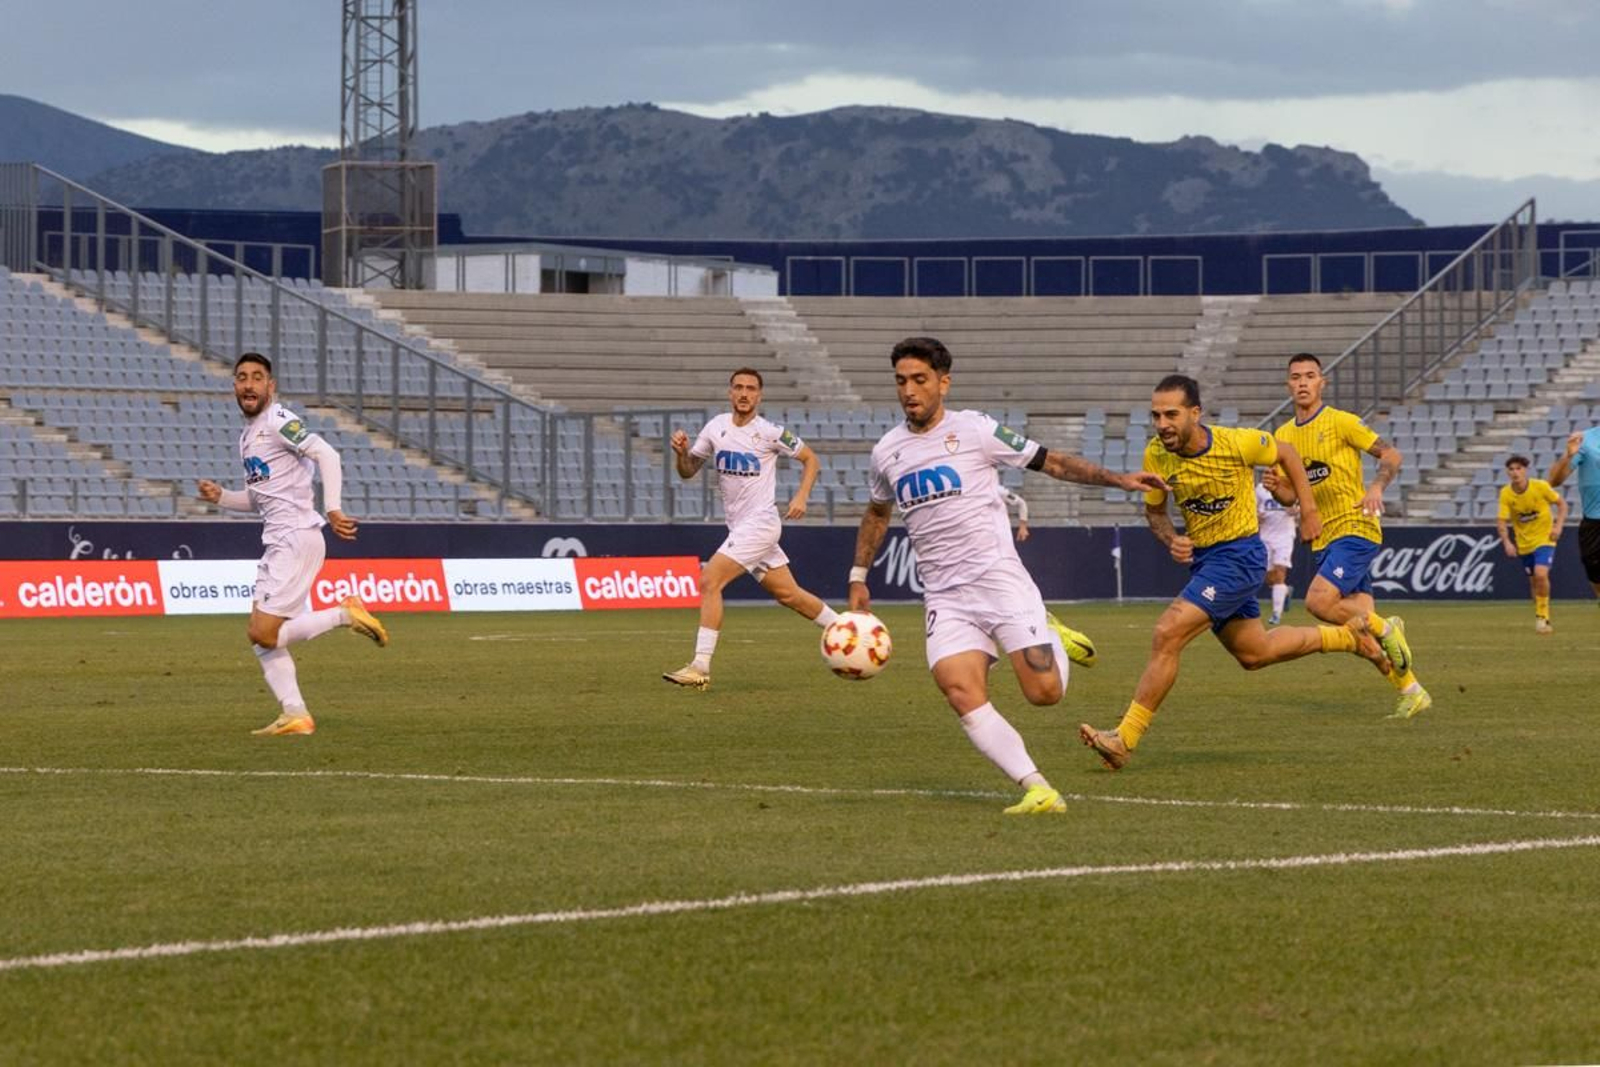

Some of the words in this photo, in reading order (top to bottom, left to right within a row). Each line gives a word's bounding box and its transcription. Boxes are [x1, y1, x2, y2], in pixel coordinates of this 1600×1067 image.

[1371, 534, 1502, 593] ca-Cola
[170, 582, 219, 599] obras
[453, 580, 498, 596] obras
[501, 579, 573, 595] maestras
